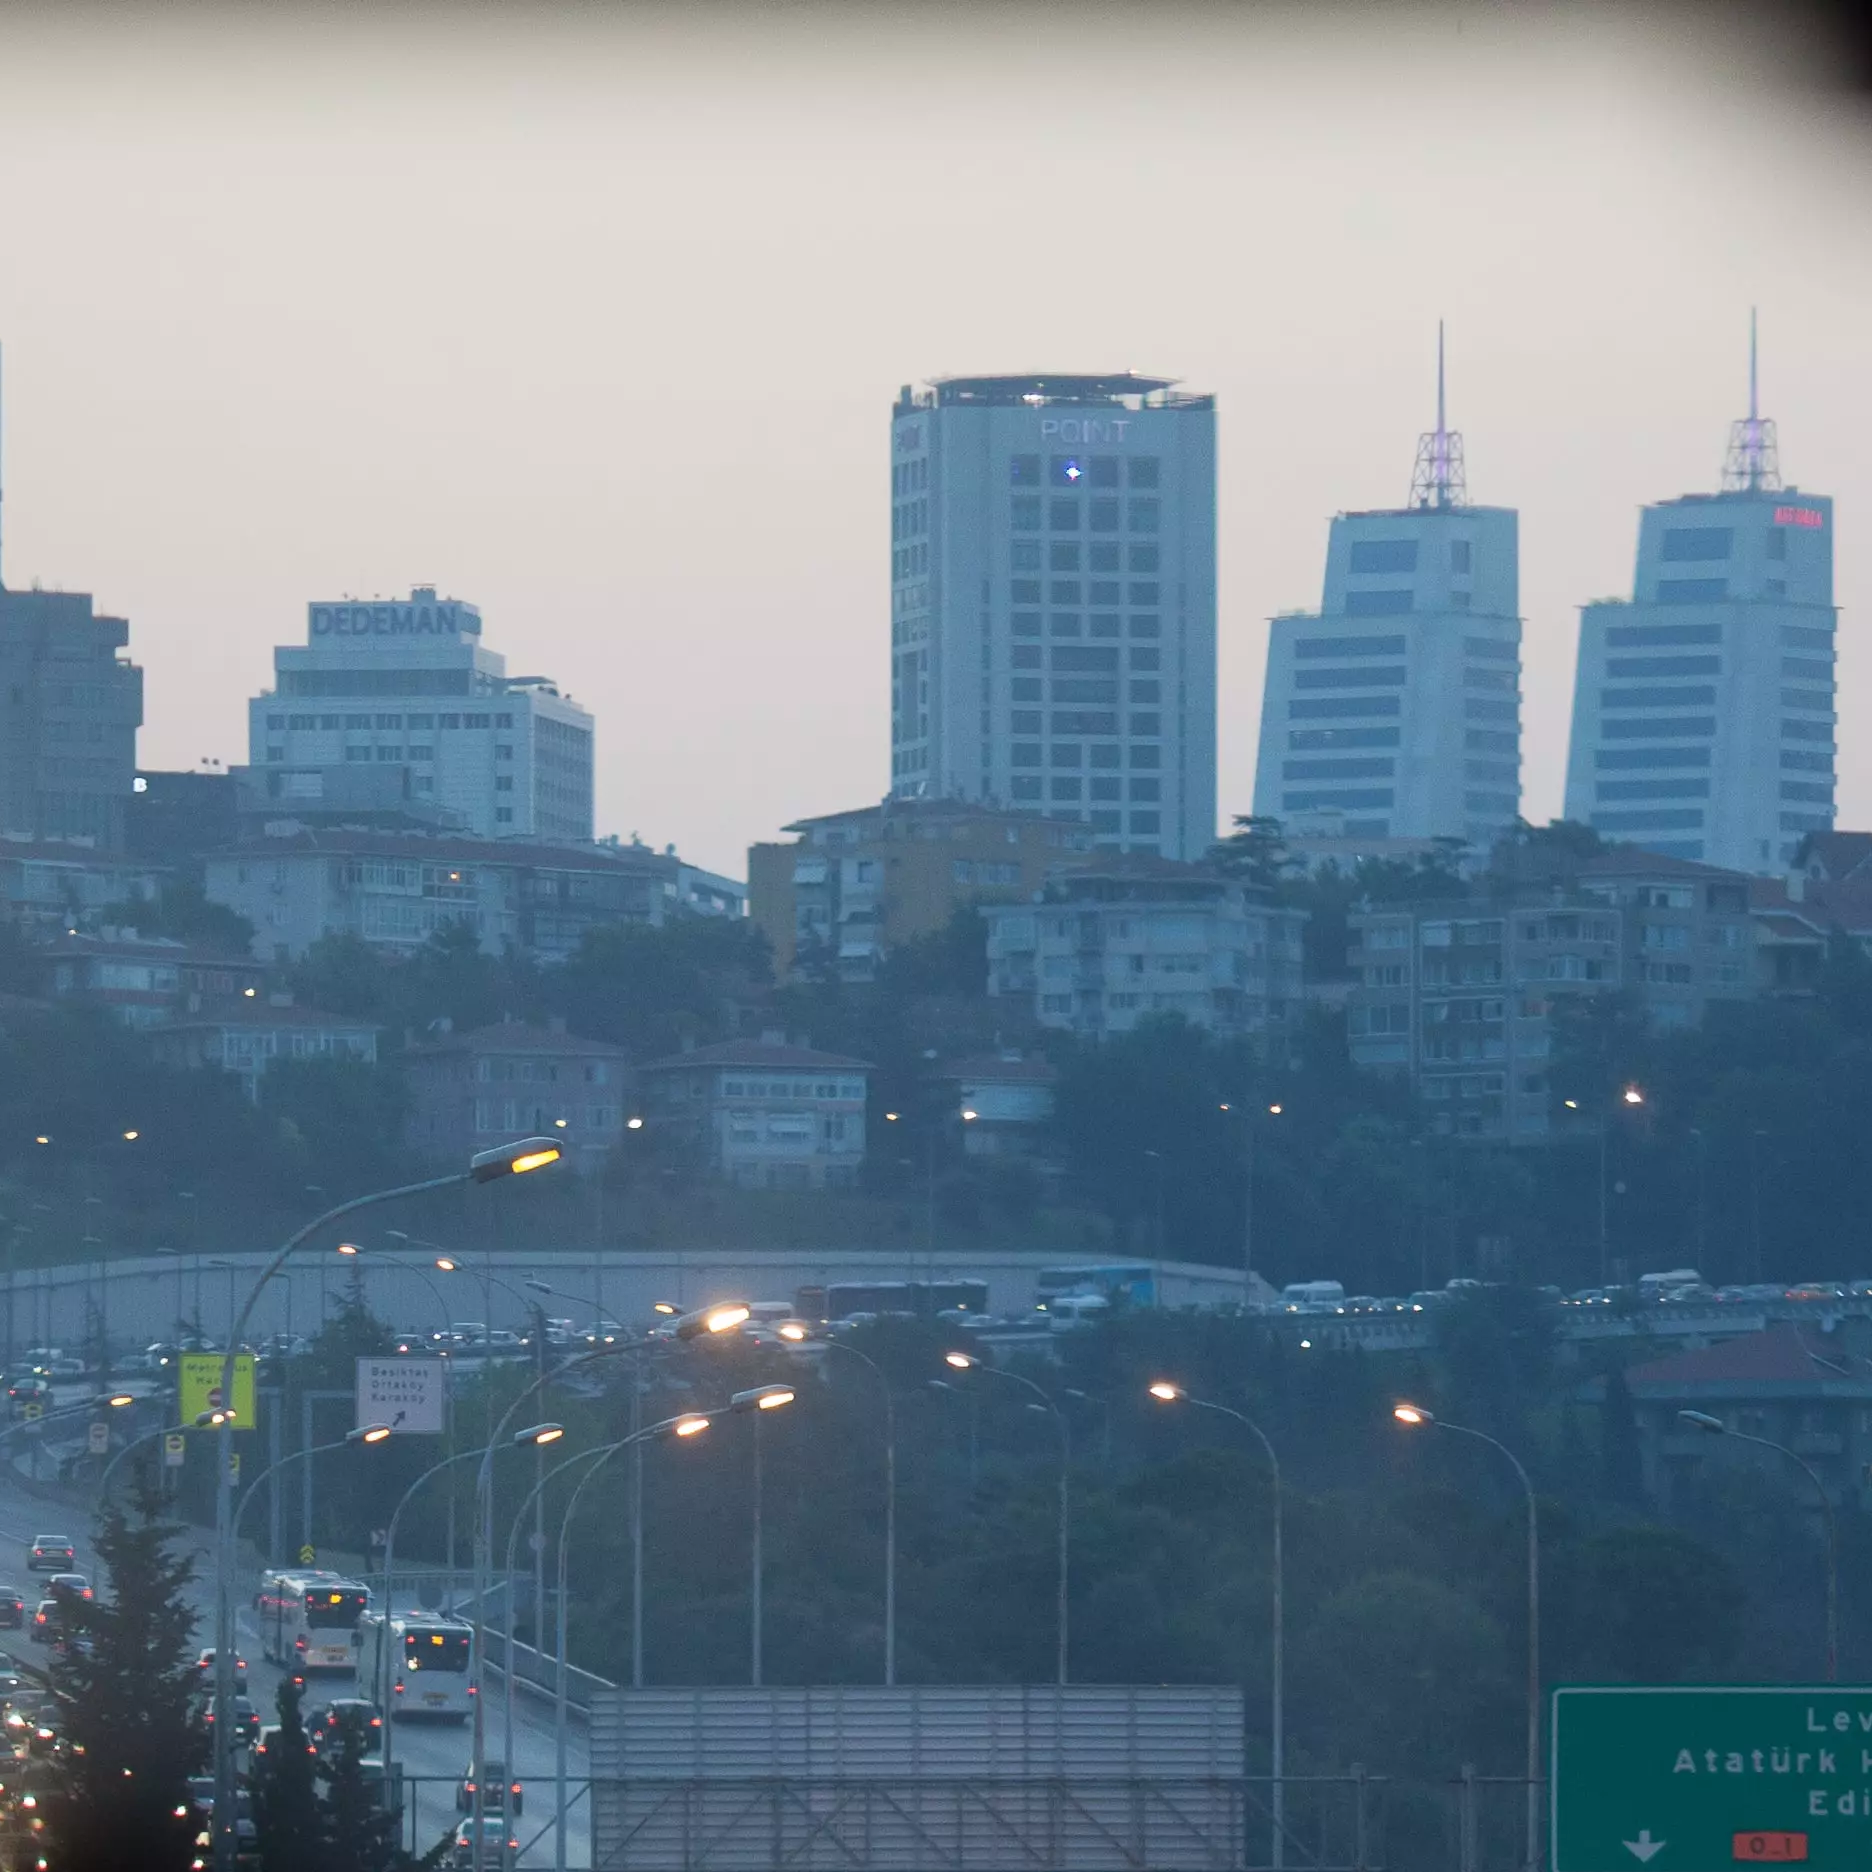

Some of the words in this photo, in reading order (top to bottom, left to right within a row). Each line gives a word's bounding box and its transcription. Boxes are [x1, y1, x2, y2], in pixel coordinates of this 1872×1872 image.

[1040, 419, 1131, 444] POINT
[311, 605, 457, 636] DEDEMAN
[1672, 1747, 1837, 1774] Atatürk
